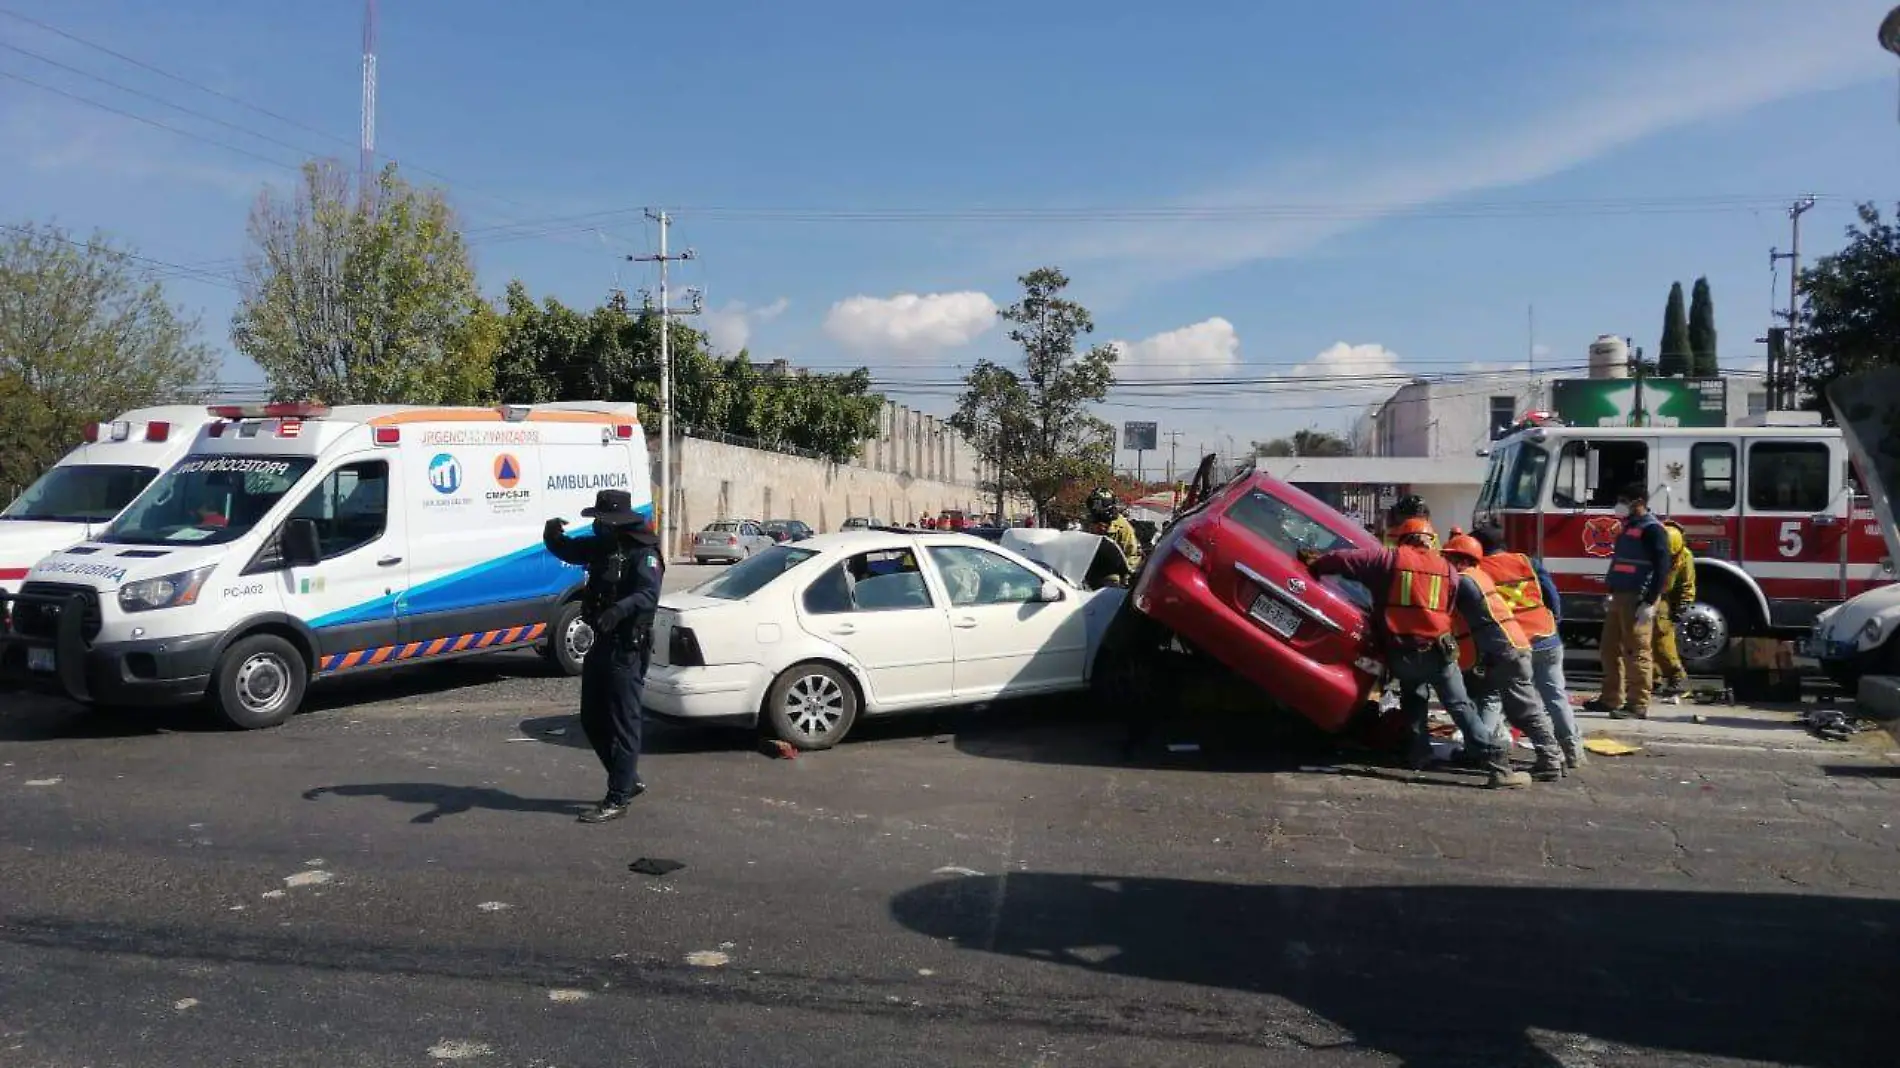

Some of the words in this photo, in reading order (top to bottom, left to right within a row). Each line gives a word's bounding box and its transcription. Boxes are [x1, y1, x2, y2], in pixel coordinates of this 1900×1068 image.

[547, 472, 629, 490] AMBULANCIA
[1778, 521, 1803, 557] 5
[223, 584, 264, 598] PC-A02
